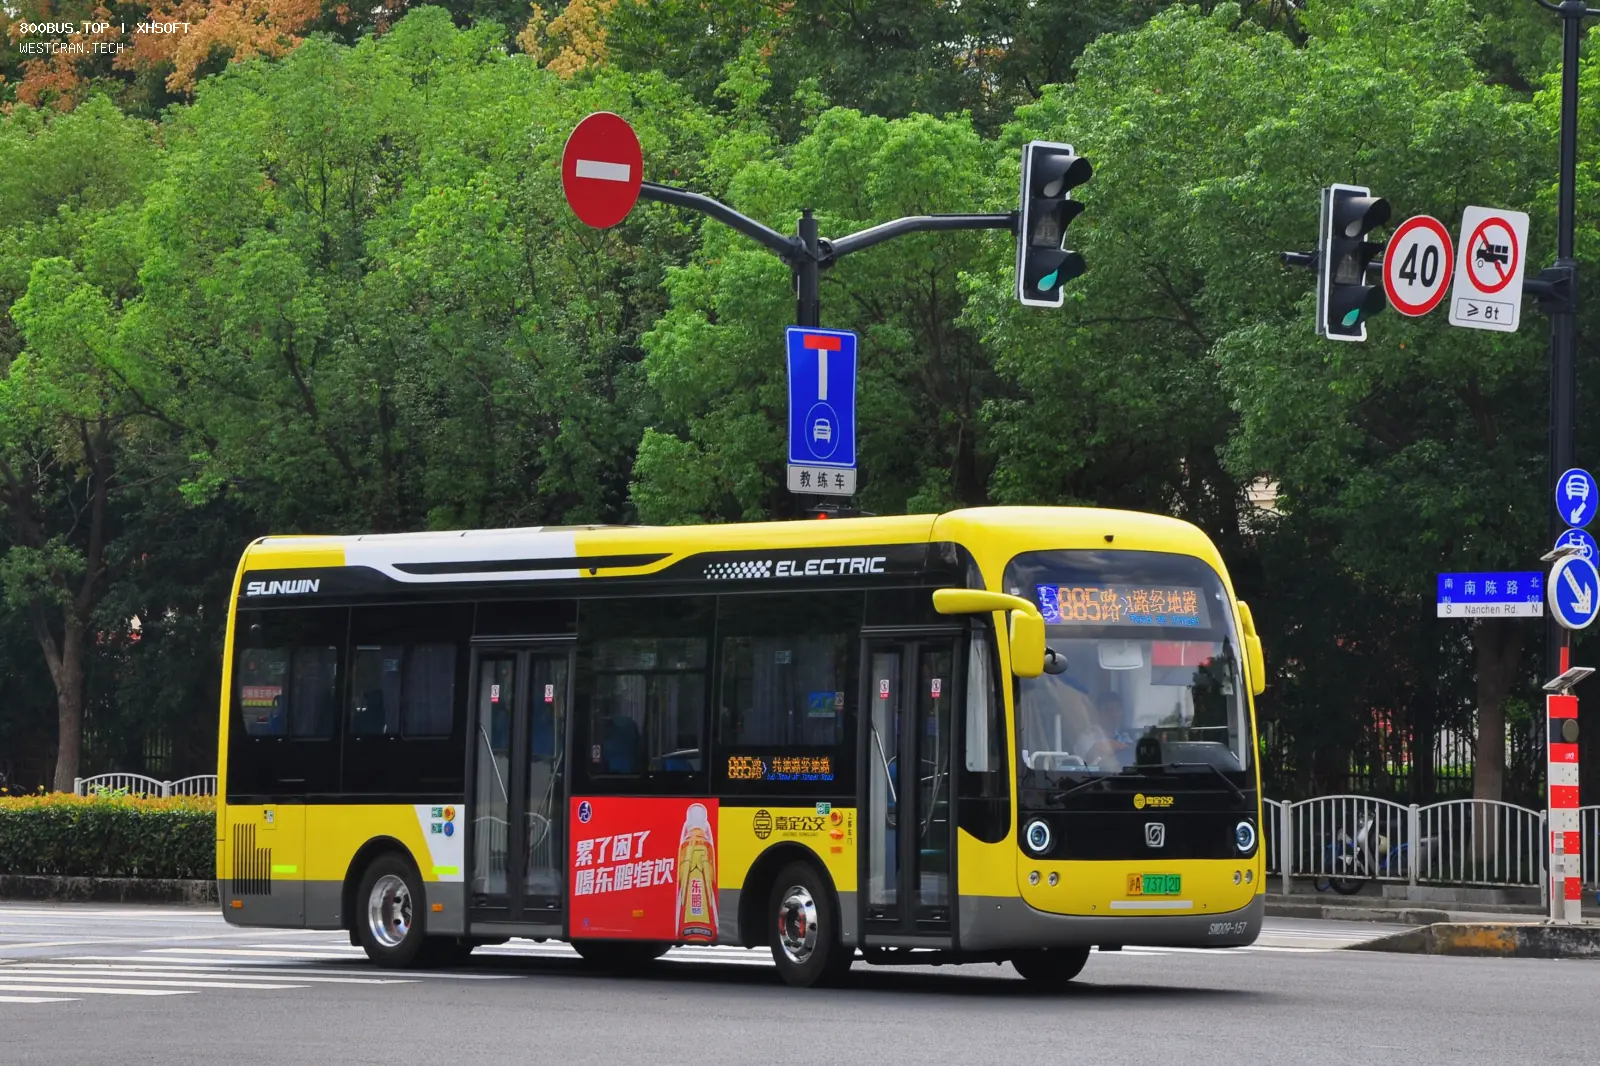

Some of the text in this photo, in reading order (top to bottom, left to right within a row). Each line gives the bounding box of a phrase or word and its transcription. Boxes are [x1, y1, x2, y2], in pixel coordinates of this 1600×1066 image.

[1399, 243, 1439, 288] 40
[1485, 306, 1500, 321] 8t
[800, 470, 845, 490] 教练车
[775, 556, 886, 577] ELECTRIC
[246, 578, 320, 597] SUNWIN
[1444, 576, 1540, 596] 南 南陈路 北
[1058, 586, 1121, 623] 885路
[1446, 604, 1453, 614] S
[1464, 604, 1501, 615] Nanchen
[1531, 603, 1539, 613] N
[774, 816, 827, 831] 嘉定公交
[574, 830, 652, 867] 累了困了
[574, 857, 676, 897] 喝东鹏特饮
